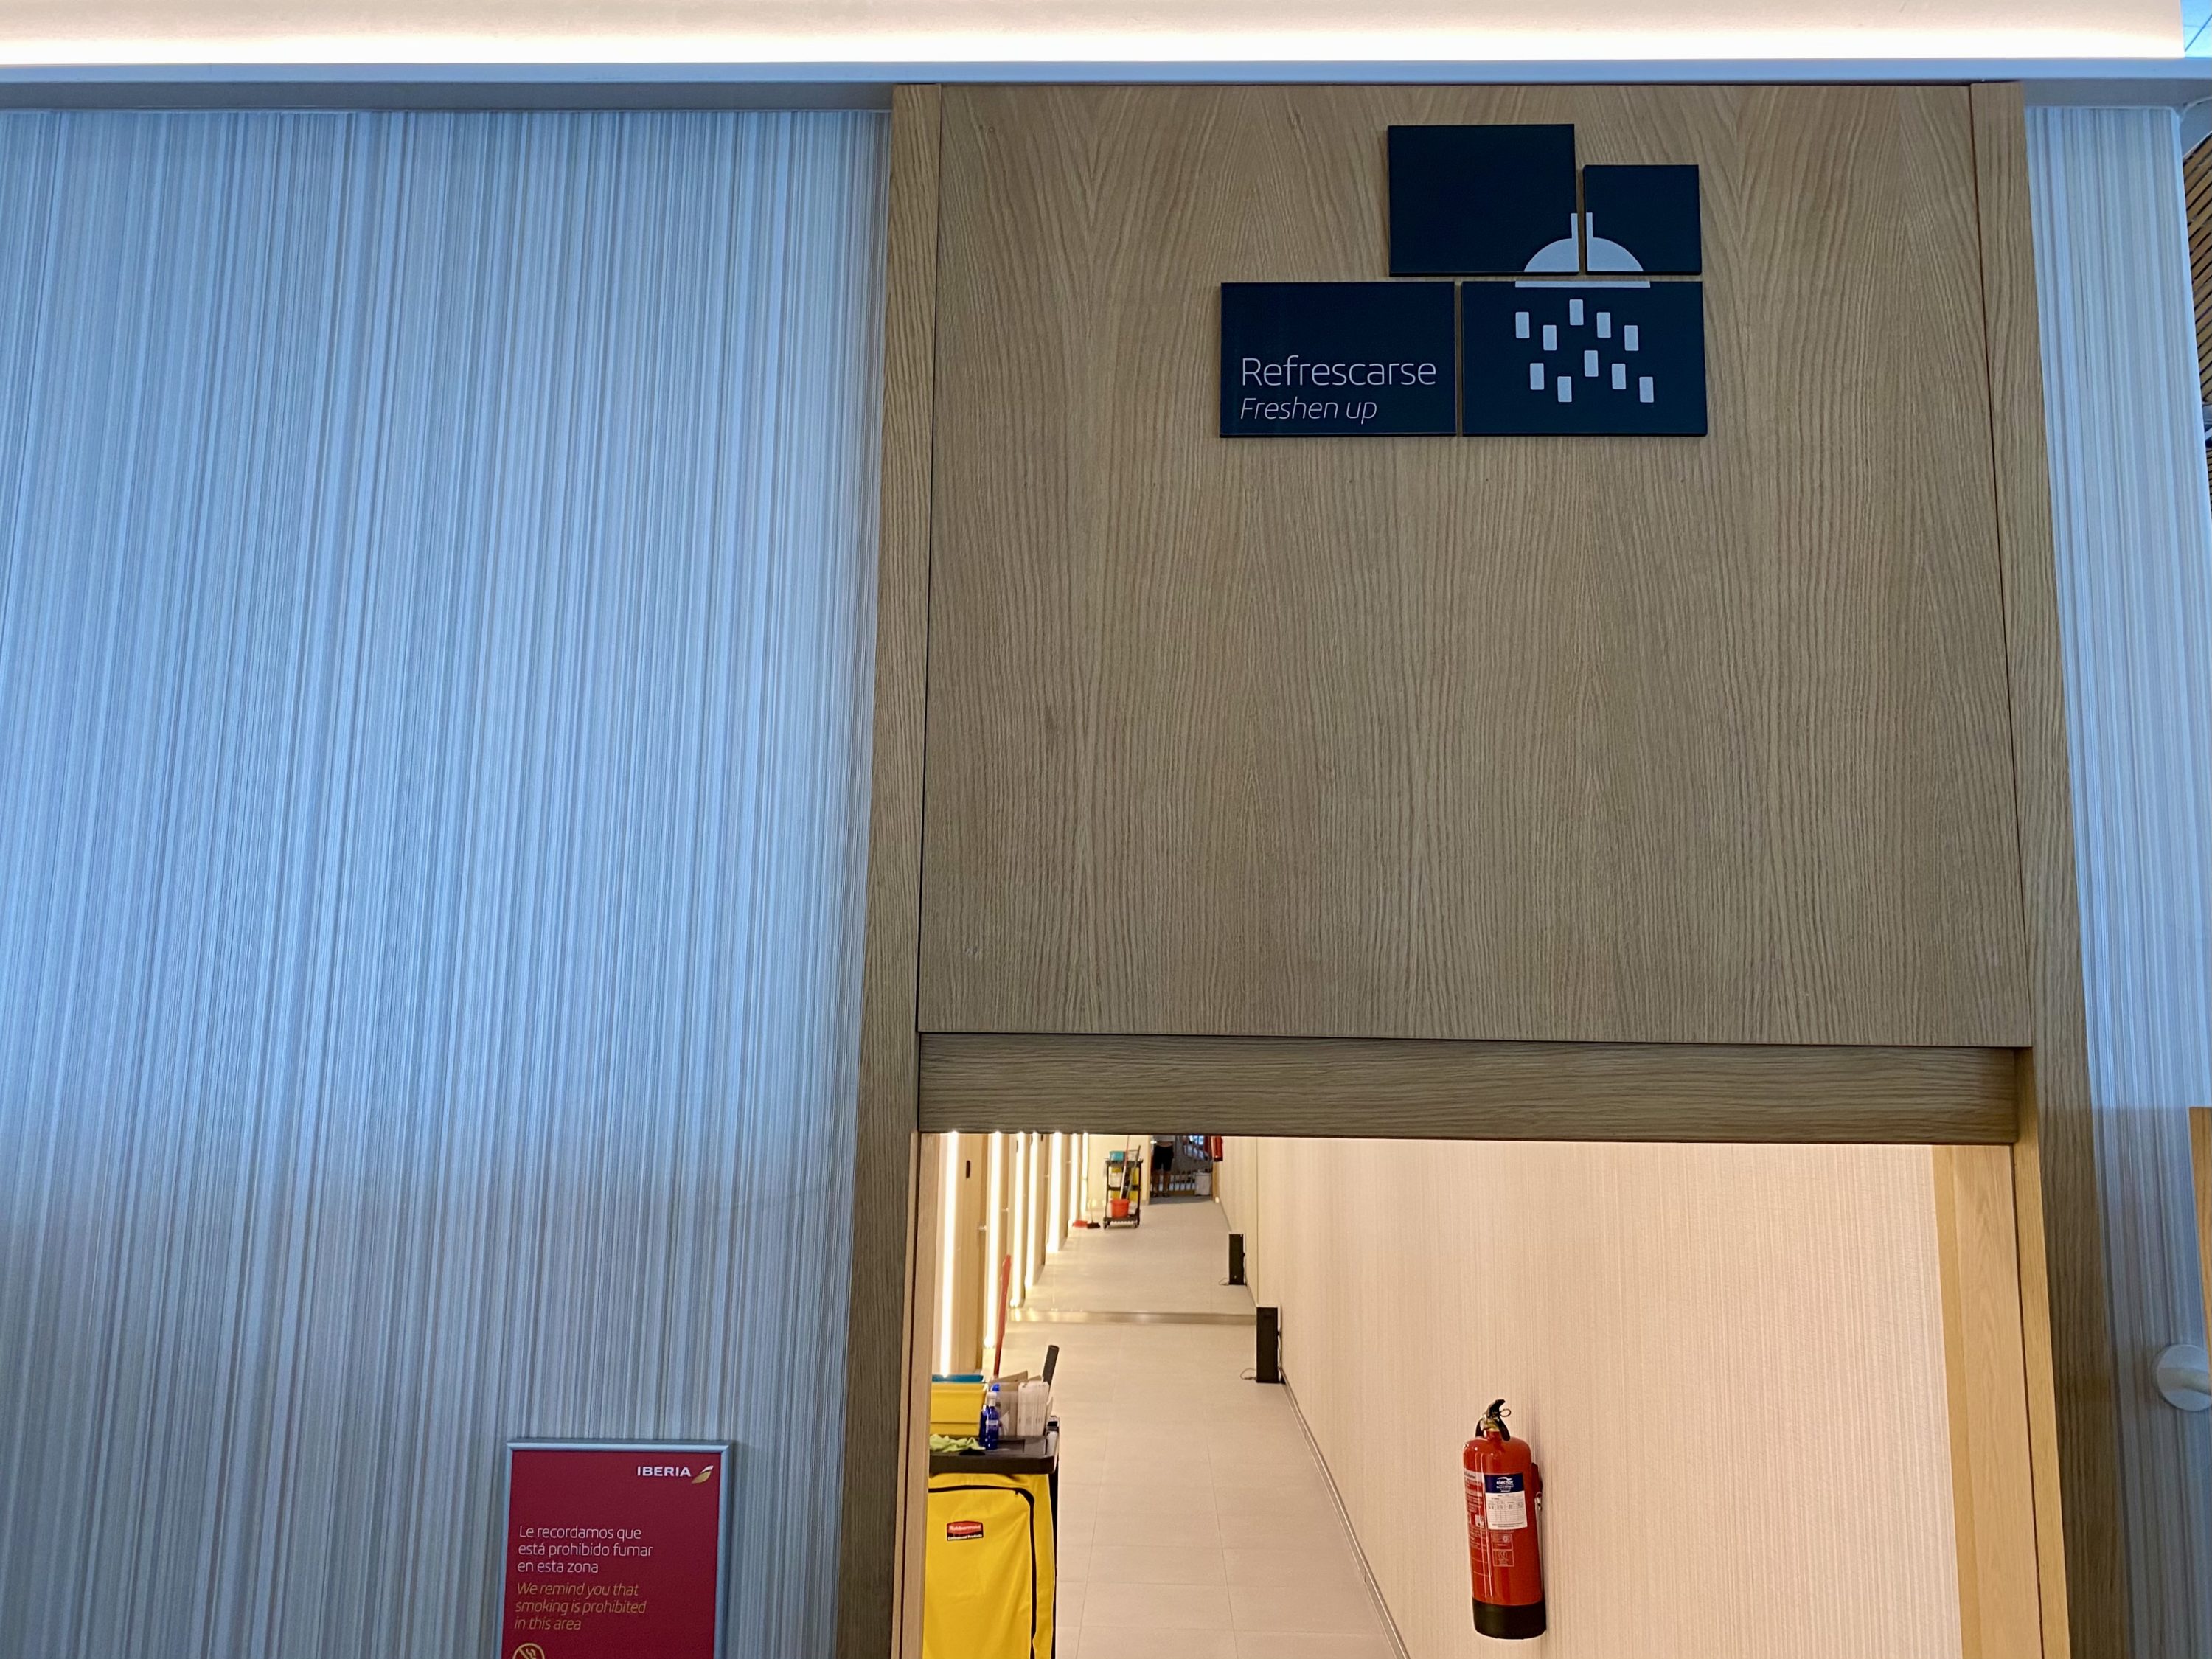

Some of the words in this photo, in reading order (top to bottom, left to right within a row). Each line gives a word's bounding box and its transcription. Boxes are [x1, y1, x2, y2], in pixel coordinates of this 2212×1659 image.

[1242, 355, 1436, 386] Refrescarse
[1241, 396, 1338, 420] Freshen
[1346, 402, 1377, 425] up
[637, 1466, 691, 1477] IBERIA
[519, 1526, 534, 1538] Le
[538, 1526, 613, 1539] recordamos
[616, 1528, 641, 1542] que
[518, 1543, 545, 1555] está
[549, 1543, 610, 1557] prohibido
[613, 1543, 653, 1557] fumar
[518, 1562, 534, 1572] en
[537, 1561, 564, 1573] esta
[567, 1562, 599, 1573] zona
[517, 1582, 538, 1595] We
[540, 1583, 584, 1596] remind
[586, 1586, 609, 1599] you
[613, 1583, 639, 1596] that
[515, 1599, 568, 1615] smoking
[571, 1600, 580, 1613] is
[582, 1600, 646, 1615] prohibited
[515, 1616, 526, 1629] in
[529, 1616, 551, 1630] this
[553, 1618, 581, 1630] area
